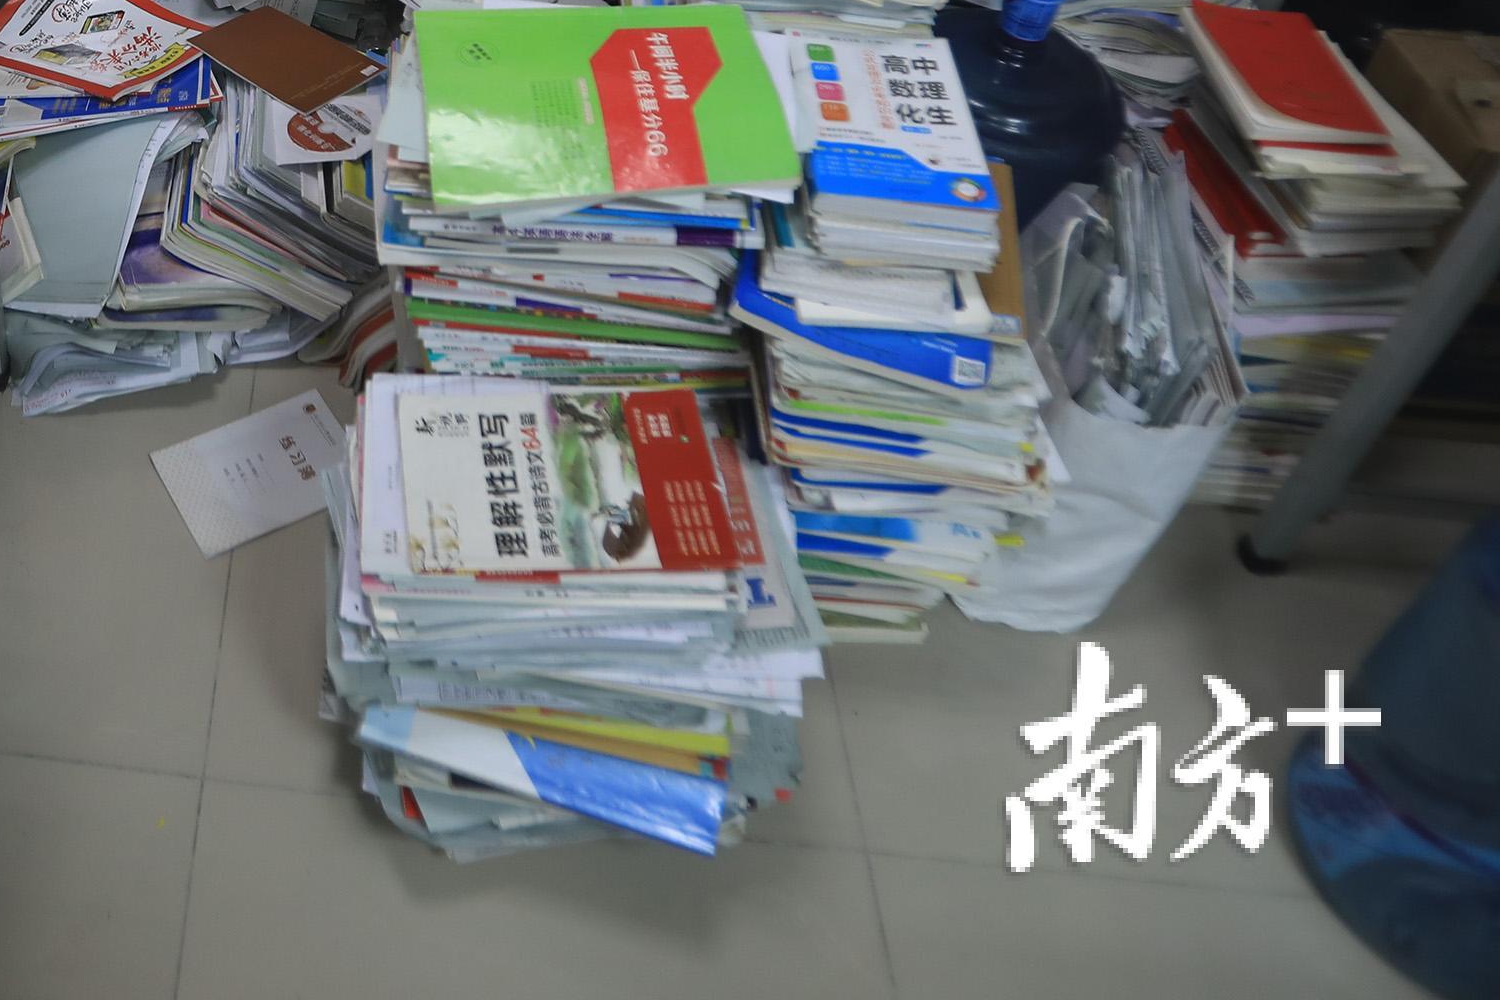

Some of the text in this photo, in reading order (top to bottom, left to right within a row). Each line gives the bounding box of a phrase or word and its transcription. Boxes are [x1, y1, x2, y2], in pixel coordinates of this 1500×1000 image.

[645, 32, 690, 100] 午间半小时
[881, 55, 940, 75] 高中
[887, 78, 949, 100] 数理
[896, 103, 957, 126] 化生
[478, 412, 529, 558] 理解性默写
[518, 412, 561, 558] 高考必背古诗文64篇
